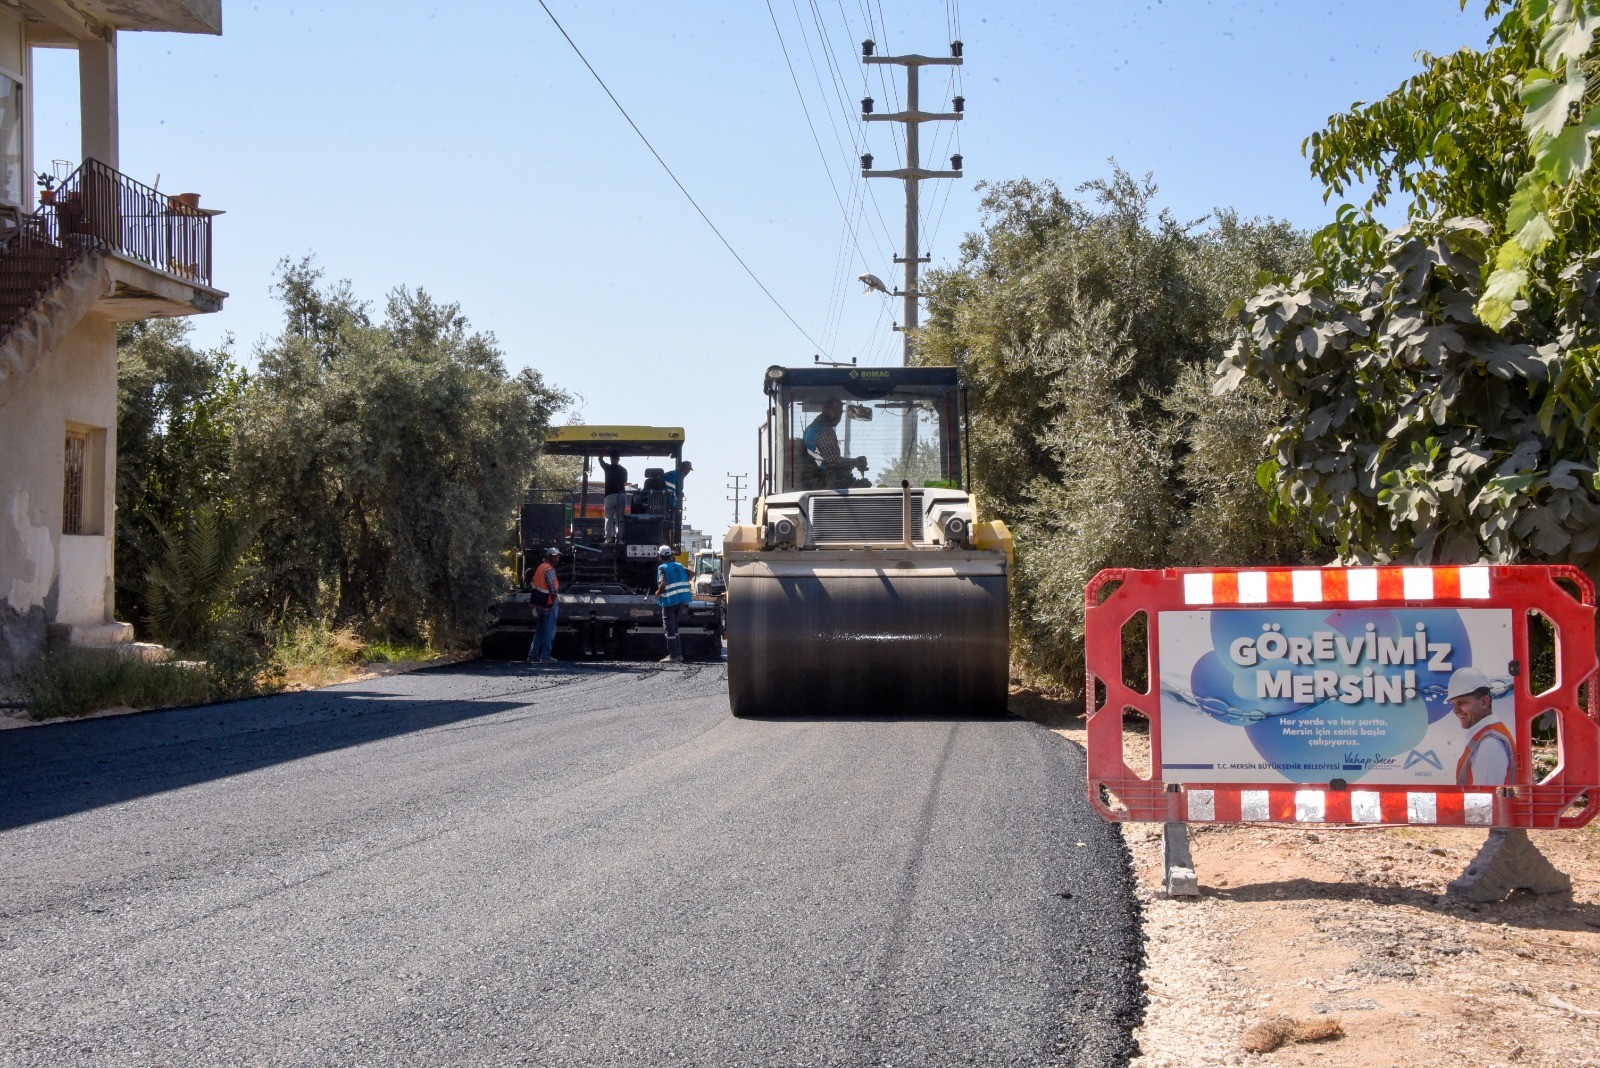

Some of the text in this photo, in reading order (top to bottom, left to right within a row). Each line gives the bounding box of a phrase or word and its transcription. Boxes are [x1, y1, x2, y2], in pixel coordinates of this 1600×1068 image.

[1229, 622, 1452, 671] GÖREVİMİZ
[1256, 667, 1416, 704] MERSİN!
[1280, 718, 1296, 726] Her
[1299, 718, 1325, 727] yerde
[1341, 718, 1355, 726] her
[1359, 718, 1388, 727] şartta,
[1283, 728, 1386, 737] Mersin için canla başla
[1309, 738, 1360, 747] çalışıyoruz.
[1344, 752, 1372, 770] Vahap
[1230, 762, 1256, 770] MERSİN
[1258, 762, 1302, 771] BÜYÜKŞEHİR
[1303, 762, 1340, 770] BELEDİYESİ
